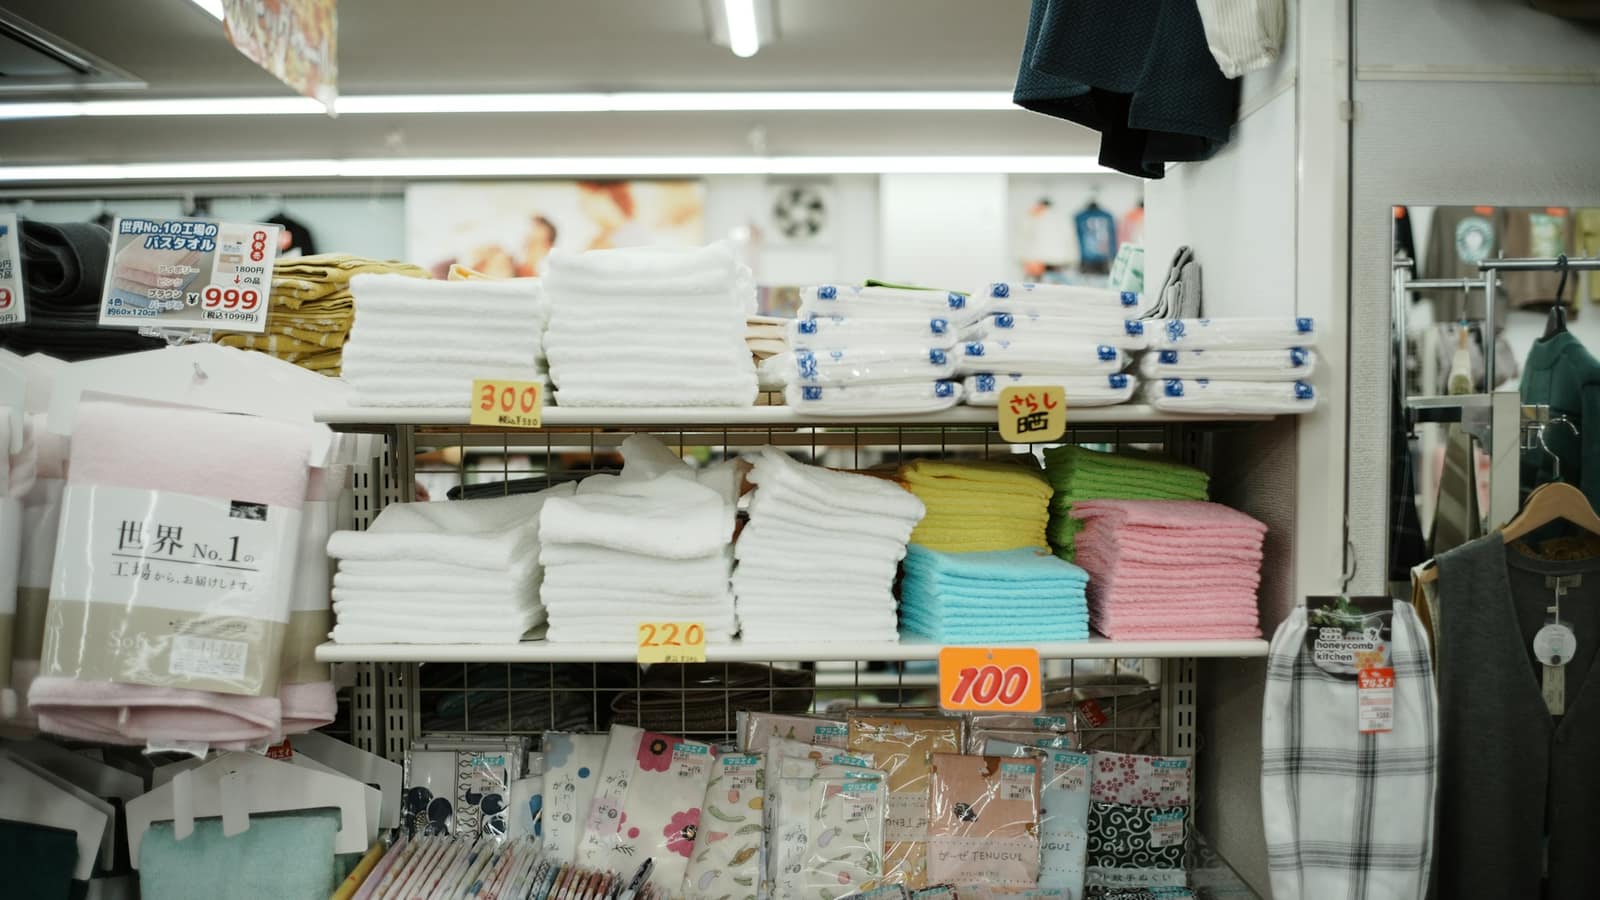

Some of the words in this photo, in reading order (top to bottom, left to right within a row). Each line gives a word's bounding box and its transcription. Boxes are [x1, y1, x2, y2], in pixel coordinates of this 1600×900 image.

[121, 220, 217, 236] 世界No.1の工場の
[145, 235, 215, 250] バスタオル
[235, 265, 264, 274] 1800円
[205, 288, 258, 310] 999
[481, 384, 537, 414] 300
[1009, 392, 1058, 415] さらし
[640, 623, 704, 648] 220
[1316, 640, 1374, 652] honeycomb
[1316, 651, 1353, 661] kitchen
[951, 666, 1029, 705] 100
[972, 851, 1023, 862] TENUGUI
